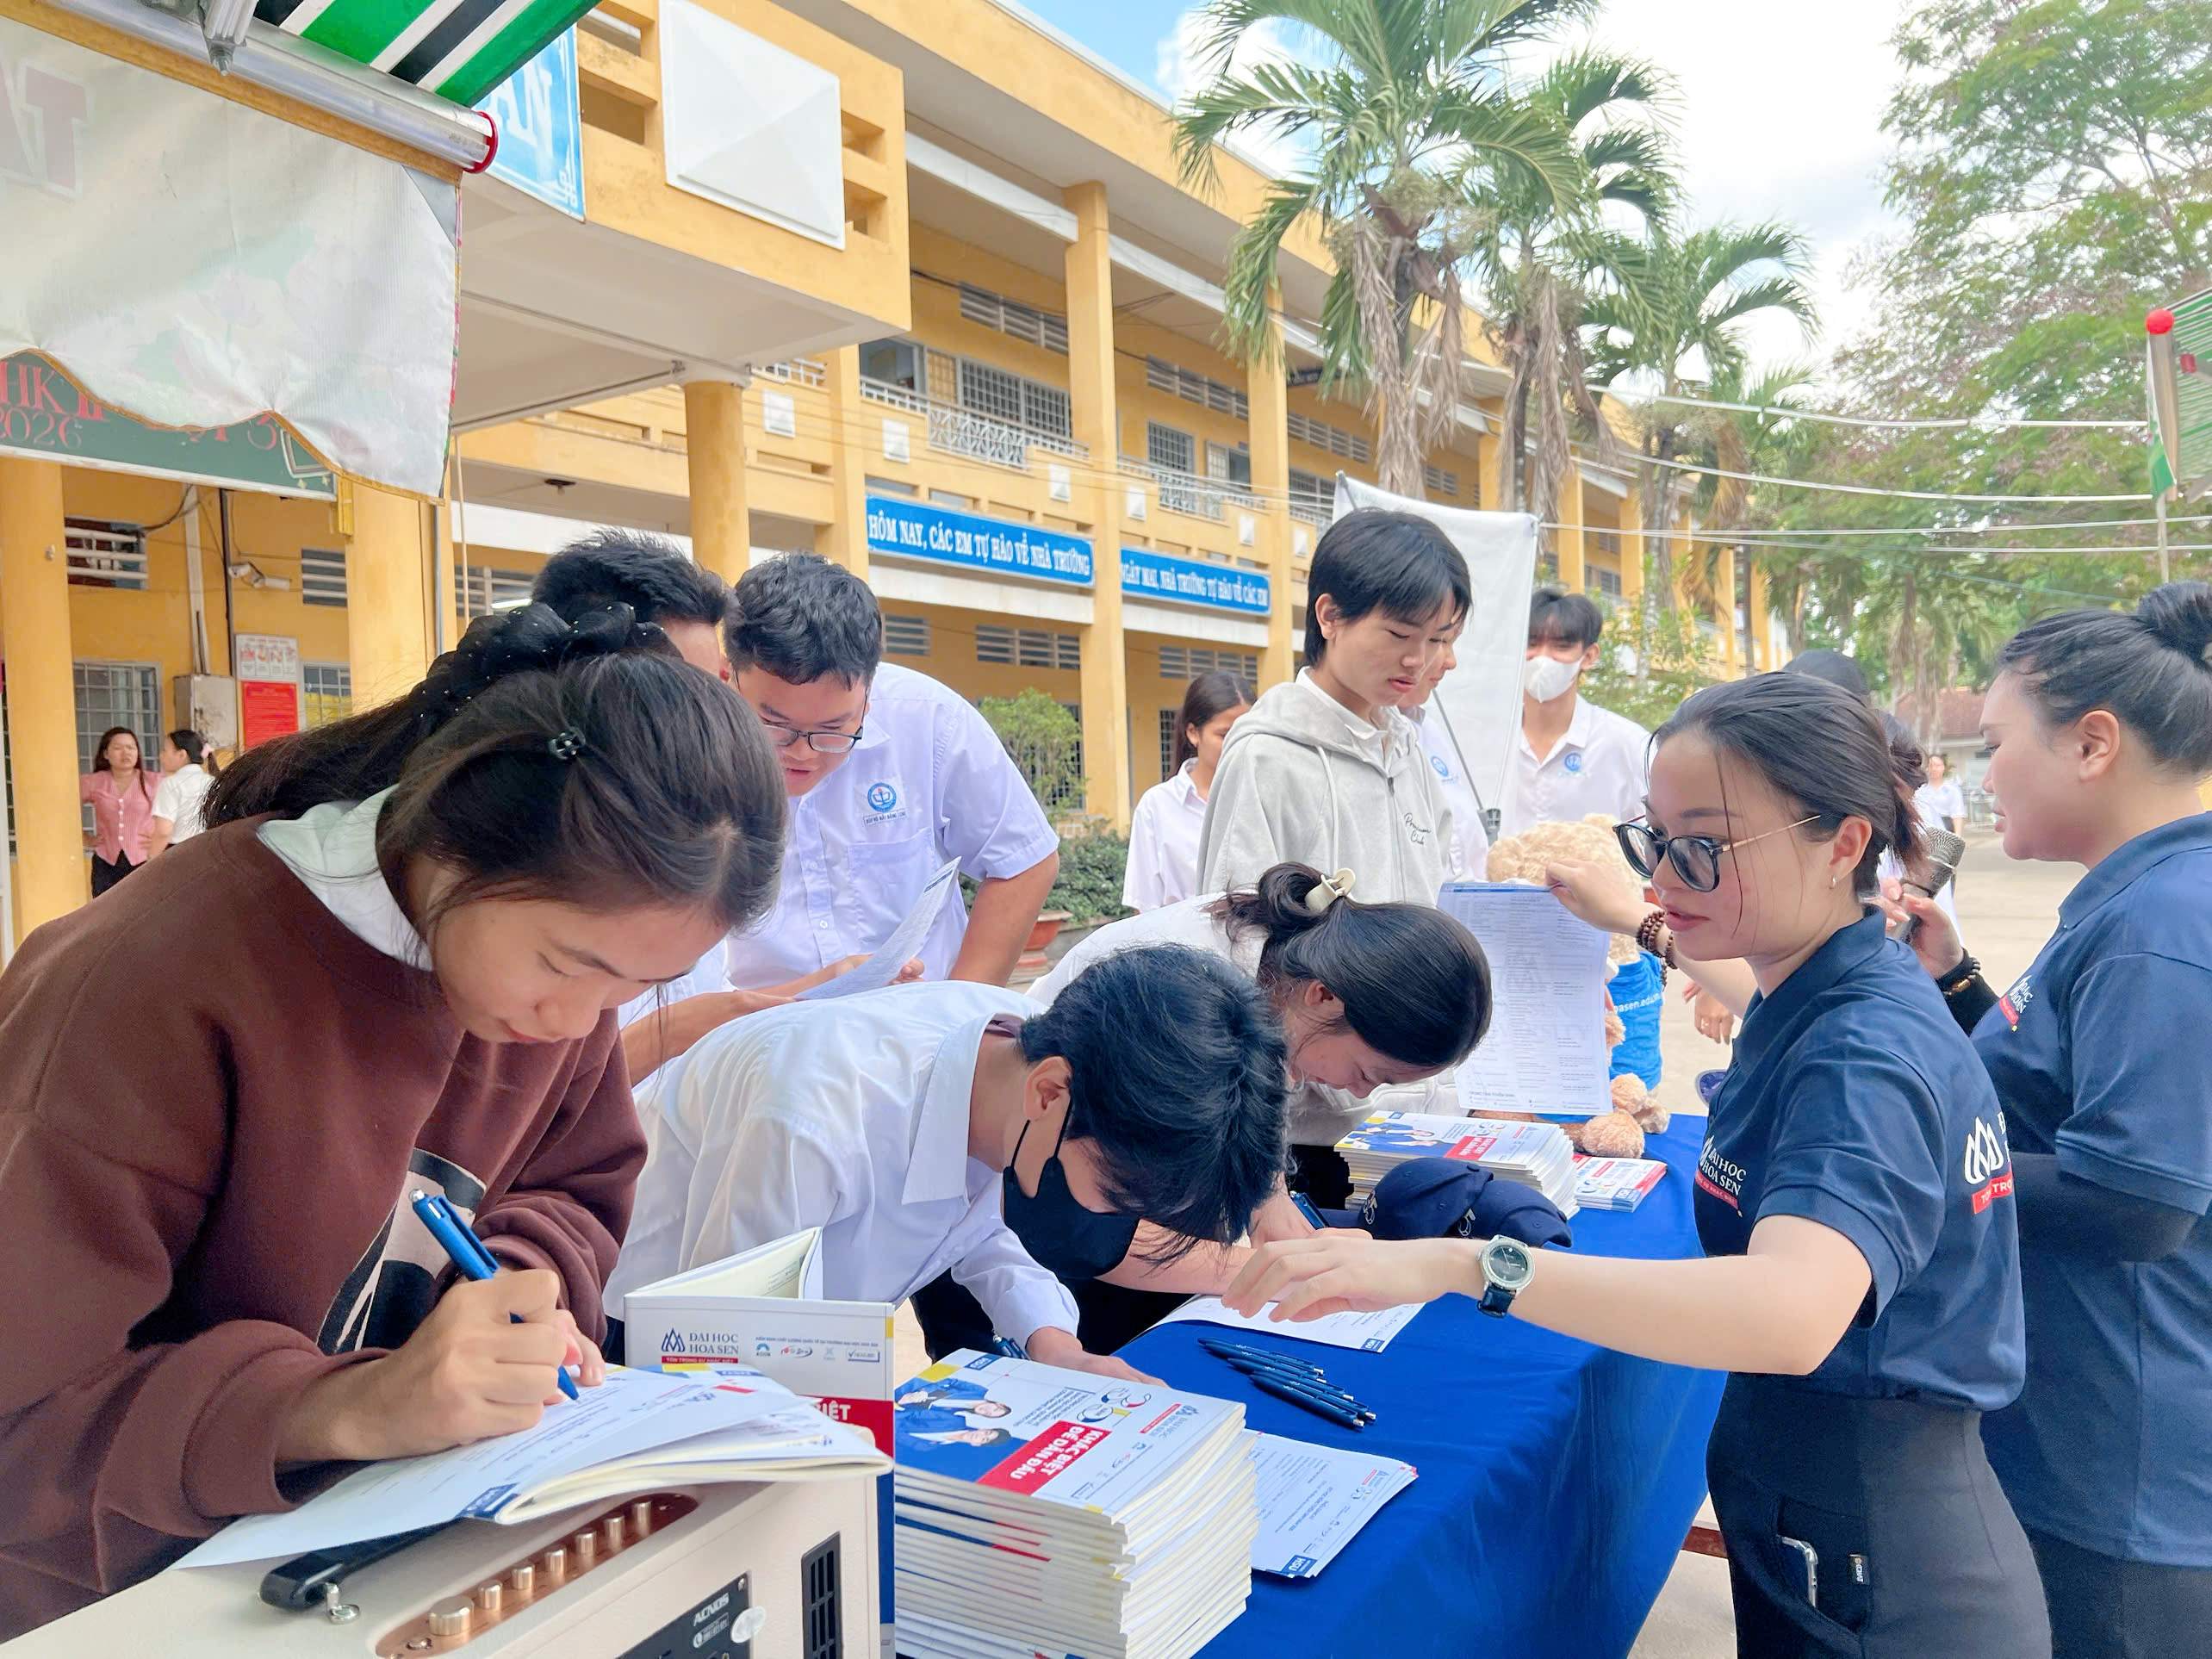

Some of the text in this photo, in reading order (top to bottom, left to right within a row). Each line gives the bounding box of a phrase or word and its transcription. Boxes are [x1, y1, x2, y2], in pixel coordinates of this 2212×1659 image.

[867, 510, 898, 543] HÔM
[929, 520, 954, 552] CÁC
[954, 530, 973, 556] EM
[974, 531, 990, 563] TỰ
[991, 532, 1014, 563] HÀO
[1014, 531, 1030, 565] VỀ
[1030, 541, 1053, 569] NHÀ
[1702, 1160, 1718, 1183] HOA
[1719, 1174, 1742, 1196] SEN
[689, 1344, 739, 1354] HOA SEN
